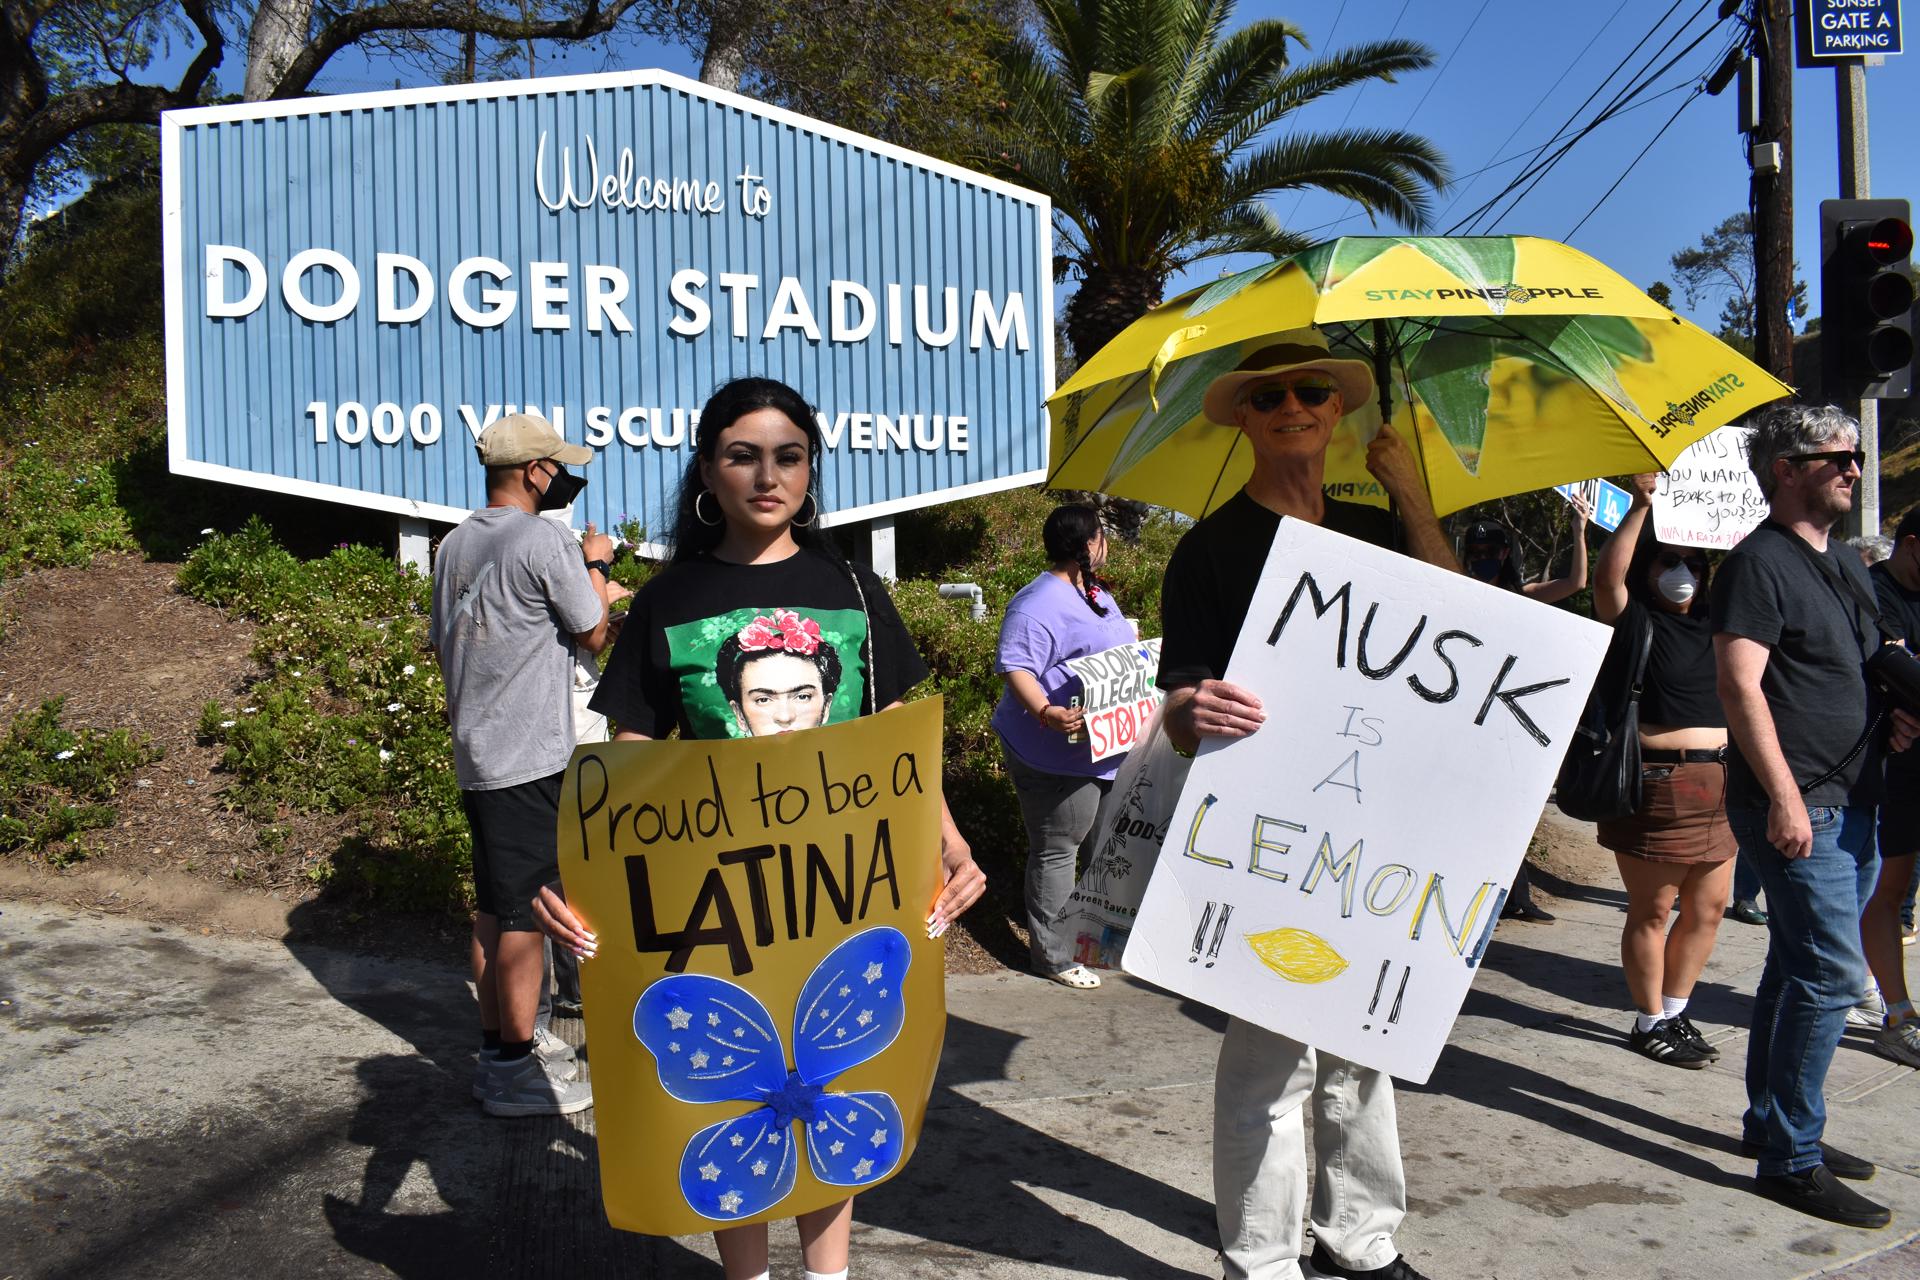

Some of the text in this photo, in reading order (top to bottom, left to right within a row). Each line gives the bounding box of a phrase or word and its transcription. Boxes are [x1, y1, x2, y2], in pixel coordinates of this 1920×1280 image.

[1821, 12, 1892, 30] GATE A
[1825, 33, 1889, 48] PARKING
[536, 129, 772, 216] Welcome to
[205, 244, 1030, 352] DODGER STADIUM
[306, 401, 443, 444] 1000
[817, 413, 970, 451] VENUE
[1700, 468, 1748, 485] WANT
[1070, 656, 1109, 686] NO
[1104, 644, 1145, 678] ONE
[1266, 571, 1571, 749] MUSK
[1083, 669, 1152, 714] ILLEGAL
[1336, 705, 1384, 747] IS
[1312, 750, 1363, 804] A
[577, 751, 923, 861] Proud to be a
[624, 818, 901, 976] LATINA
